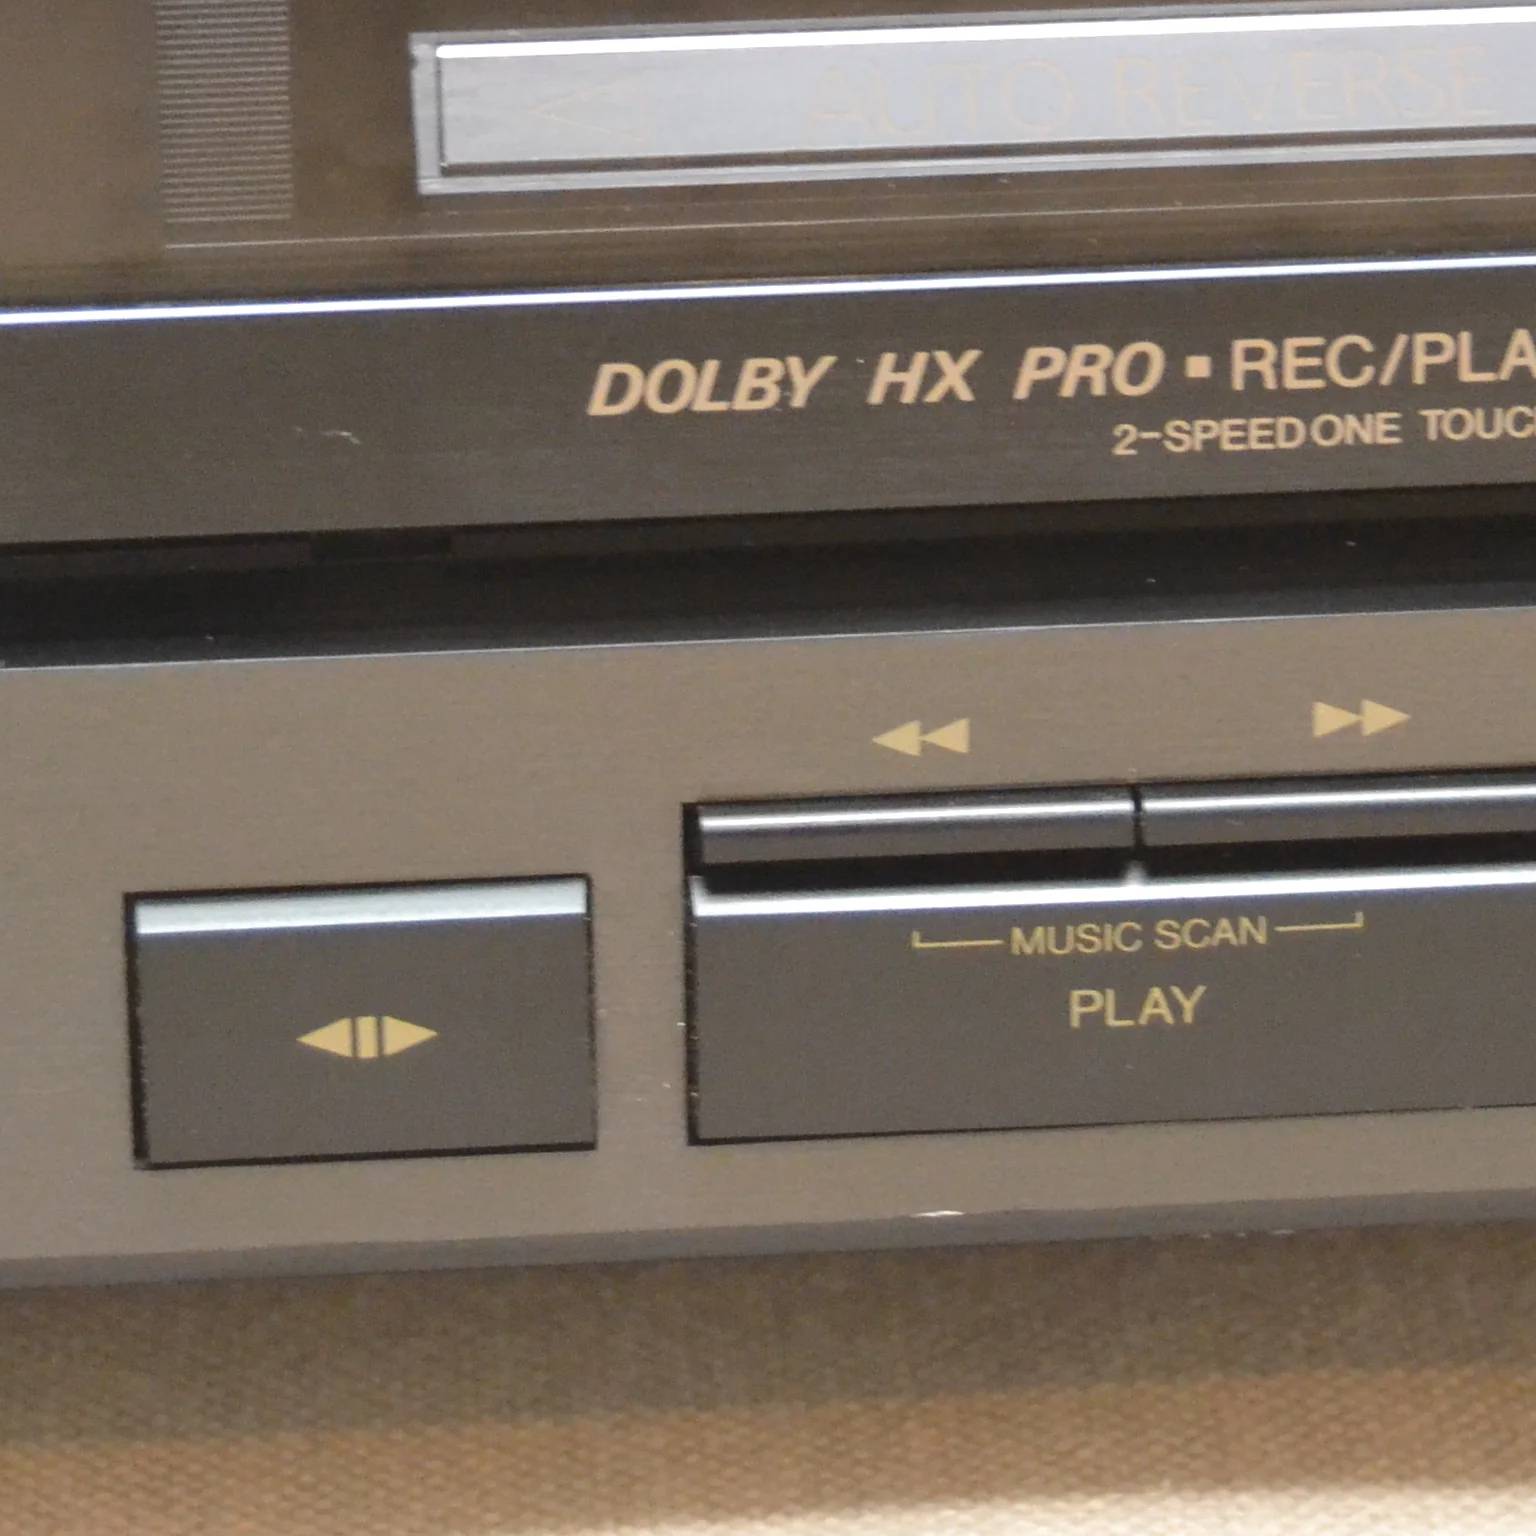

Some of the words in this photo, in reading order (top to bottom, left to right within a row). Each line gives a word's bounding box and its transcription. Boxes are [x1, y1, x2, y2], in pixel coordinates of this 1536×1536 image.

[802, 60, 1076, 143] AUTO
[1110, 44, 1496, 134] REVERSE
[587, 355, 839, 418] DOLBY
[867, 349, 983, 406] HX
[1012, 341, 1165, 401] PRO
[1011, 920, 1144, 956] MUSIC
[1154, 915, 1268, 951] SCAN
[1069, 985, 1207, 1029] PLAY
